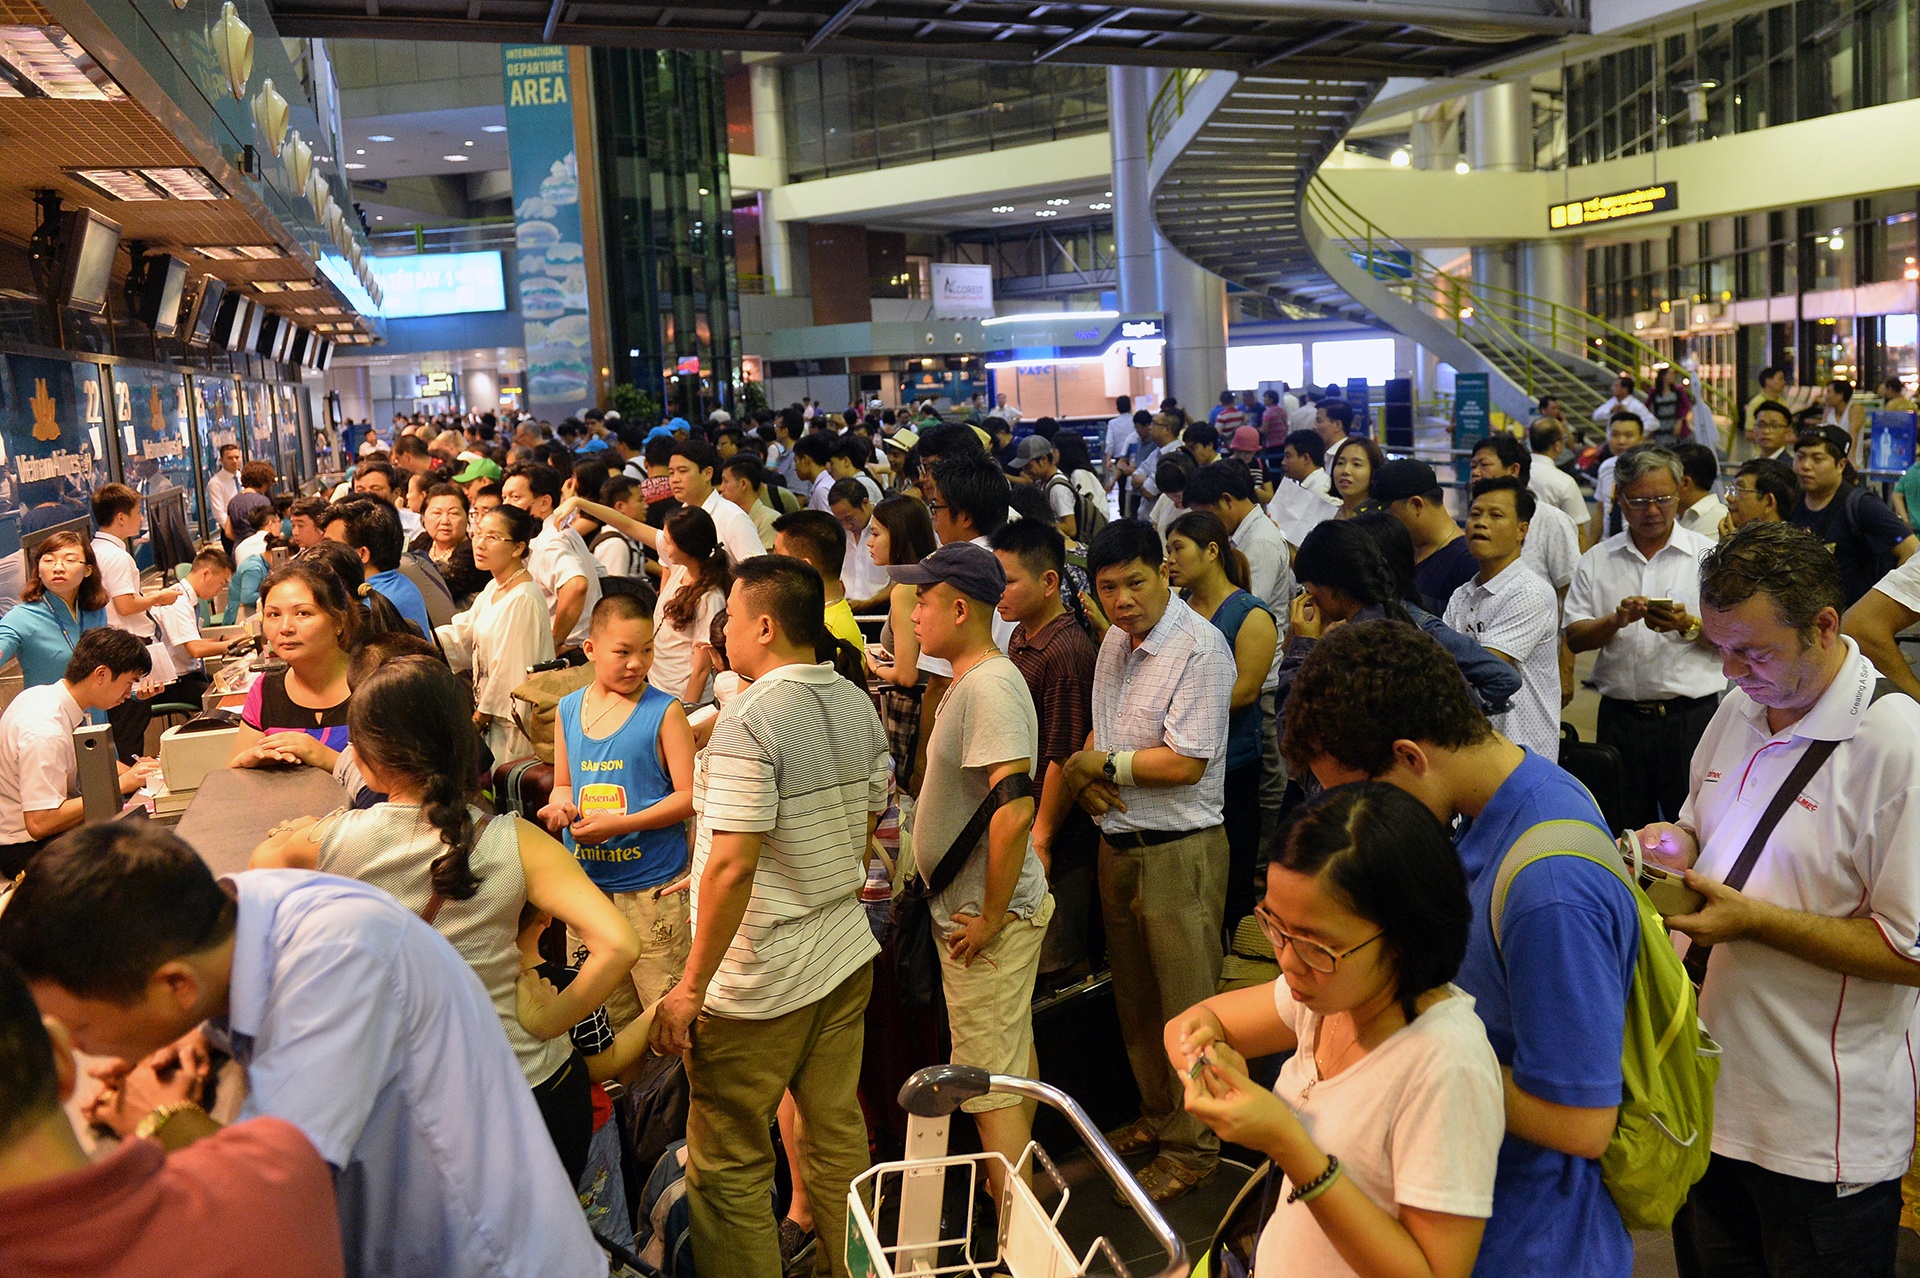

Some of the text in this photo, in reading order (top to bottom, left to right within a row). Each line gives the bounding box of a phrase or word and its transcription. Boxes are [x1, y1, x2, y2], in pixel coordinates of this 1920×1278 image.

[507, 60, 565, 77] DEPARTURE
[510, 76, 568, 107] AREA
[583, 793, 619, 804] Arsenal
[1797, 795, 1819, 812] LMEC
[573, 843, 643, 862] Emirates
